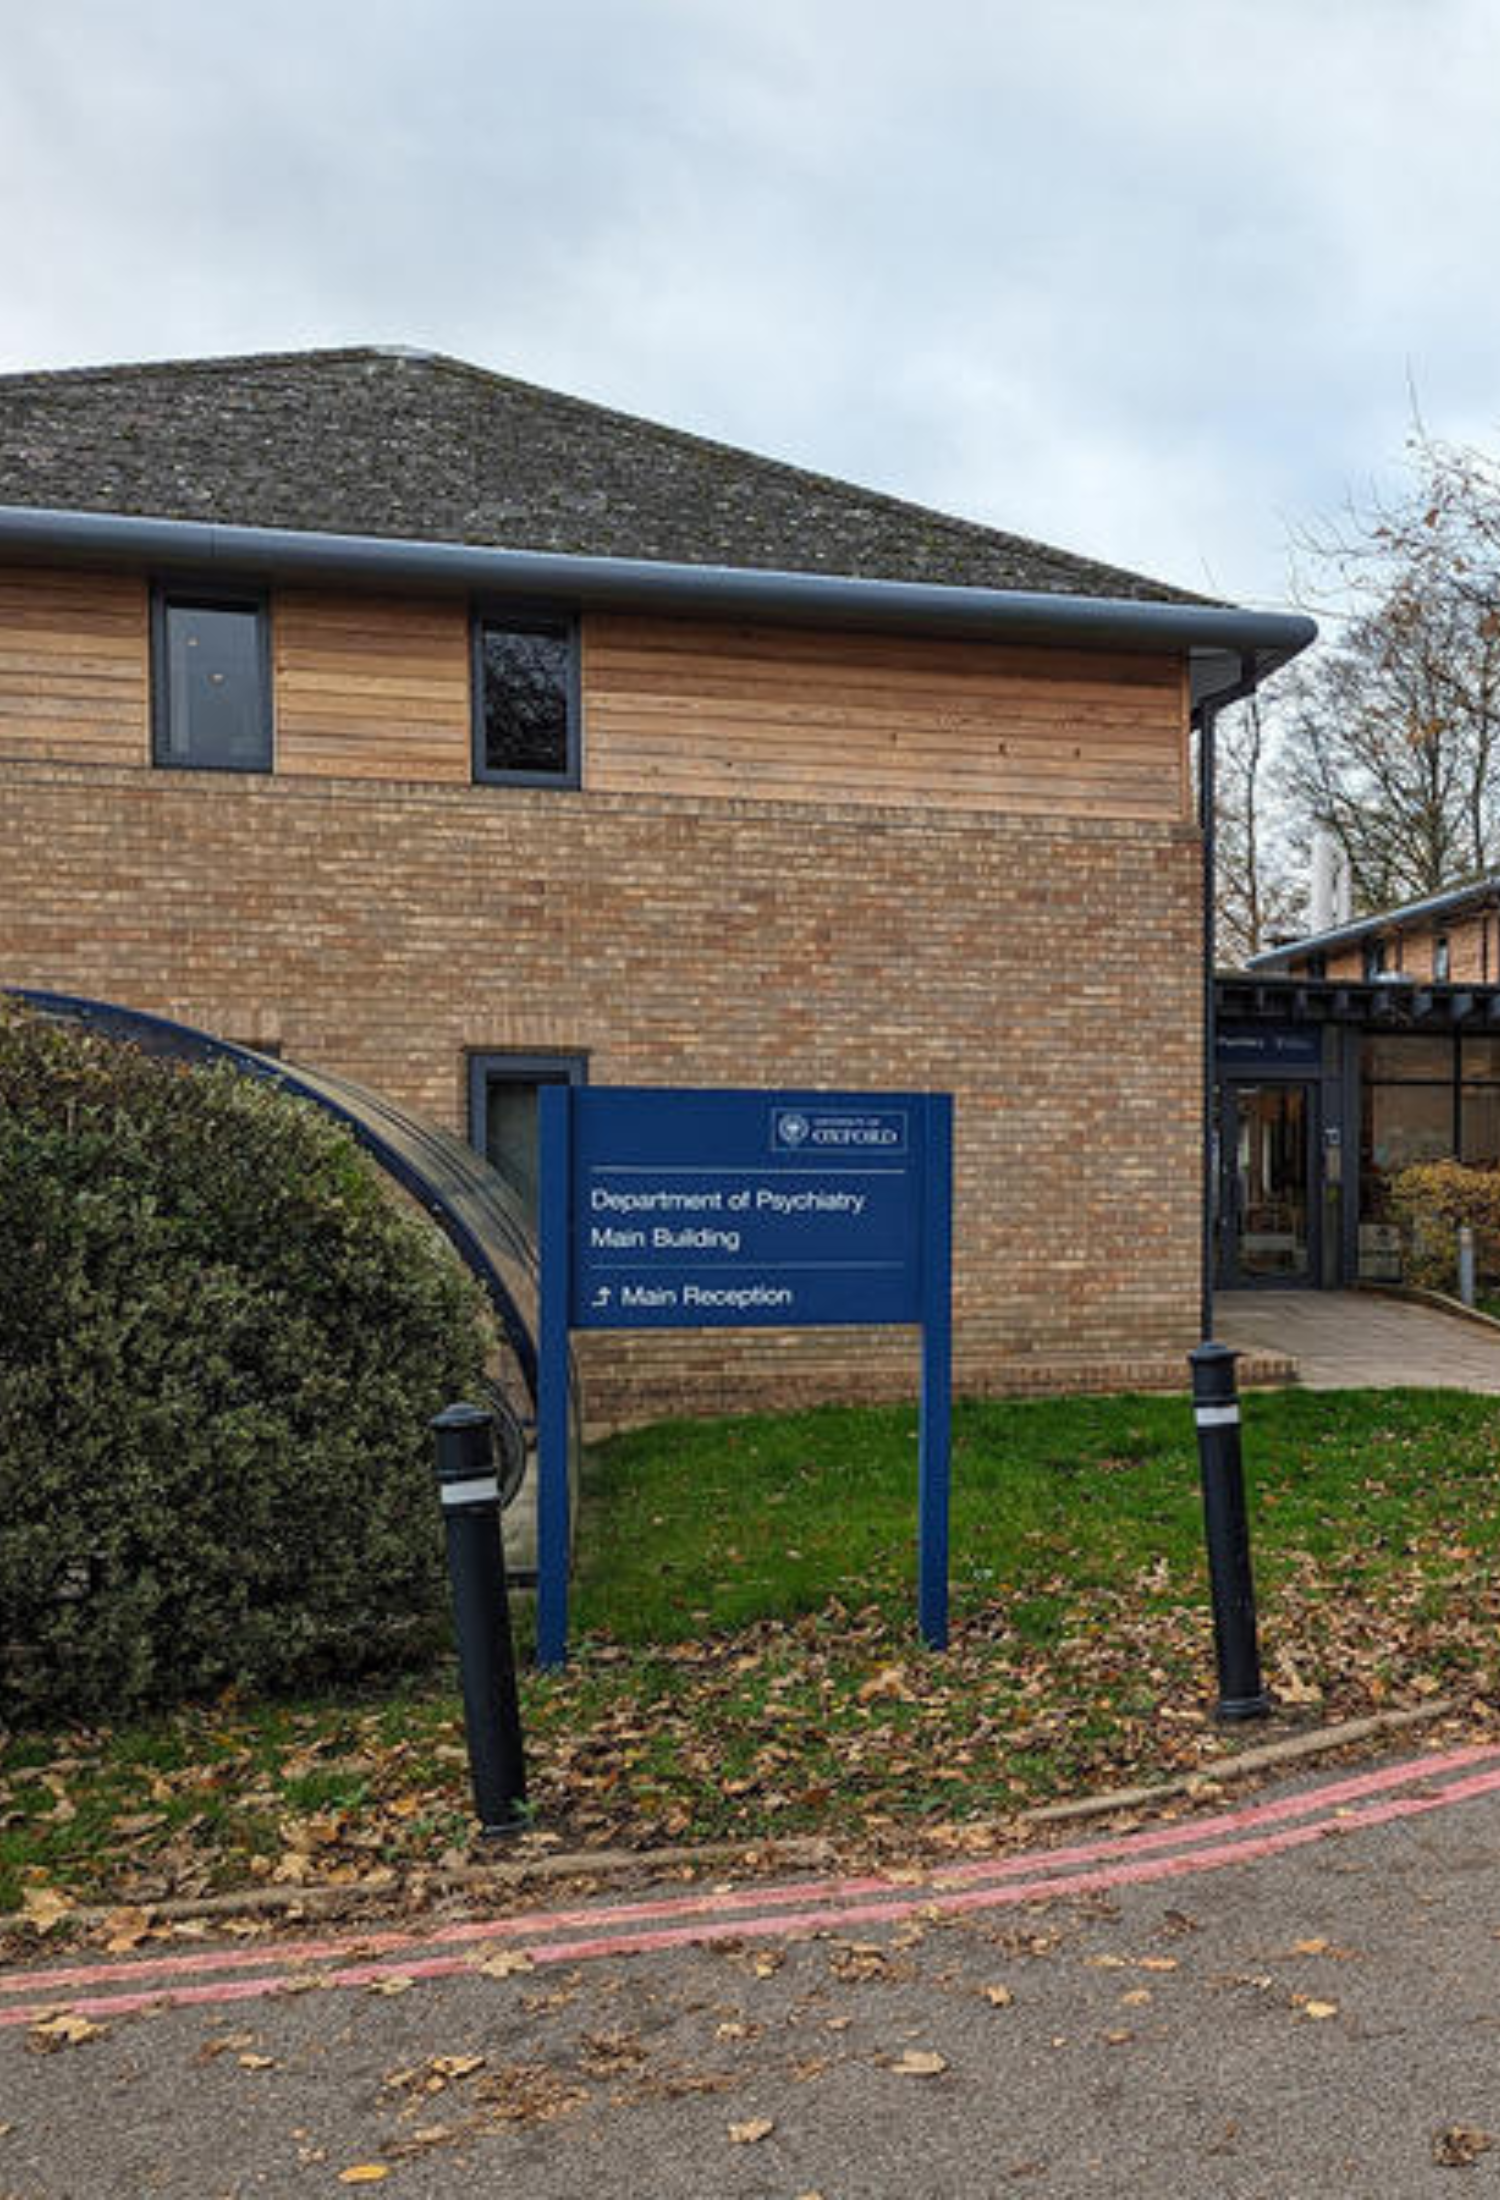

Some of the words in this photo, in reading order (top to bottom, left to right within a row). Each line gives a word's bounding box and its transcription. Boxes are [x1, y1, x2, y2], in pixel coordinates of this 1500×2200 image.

[591, 1188, 722, 1214] Department
[727, 1190, 751, 1211] of
[756, 1189, 865, 1214] Psychiatry
[591, 1227, 645, 1248] Main
[652, 1227, 740, 1252] Building
[621, 1286, 677, 1307] Main
[683, 1285, 792, 1309] Reception
